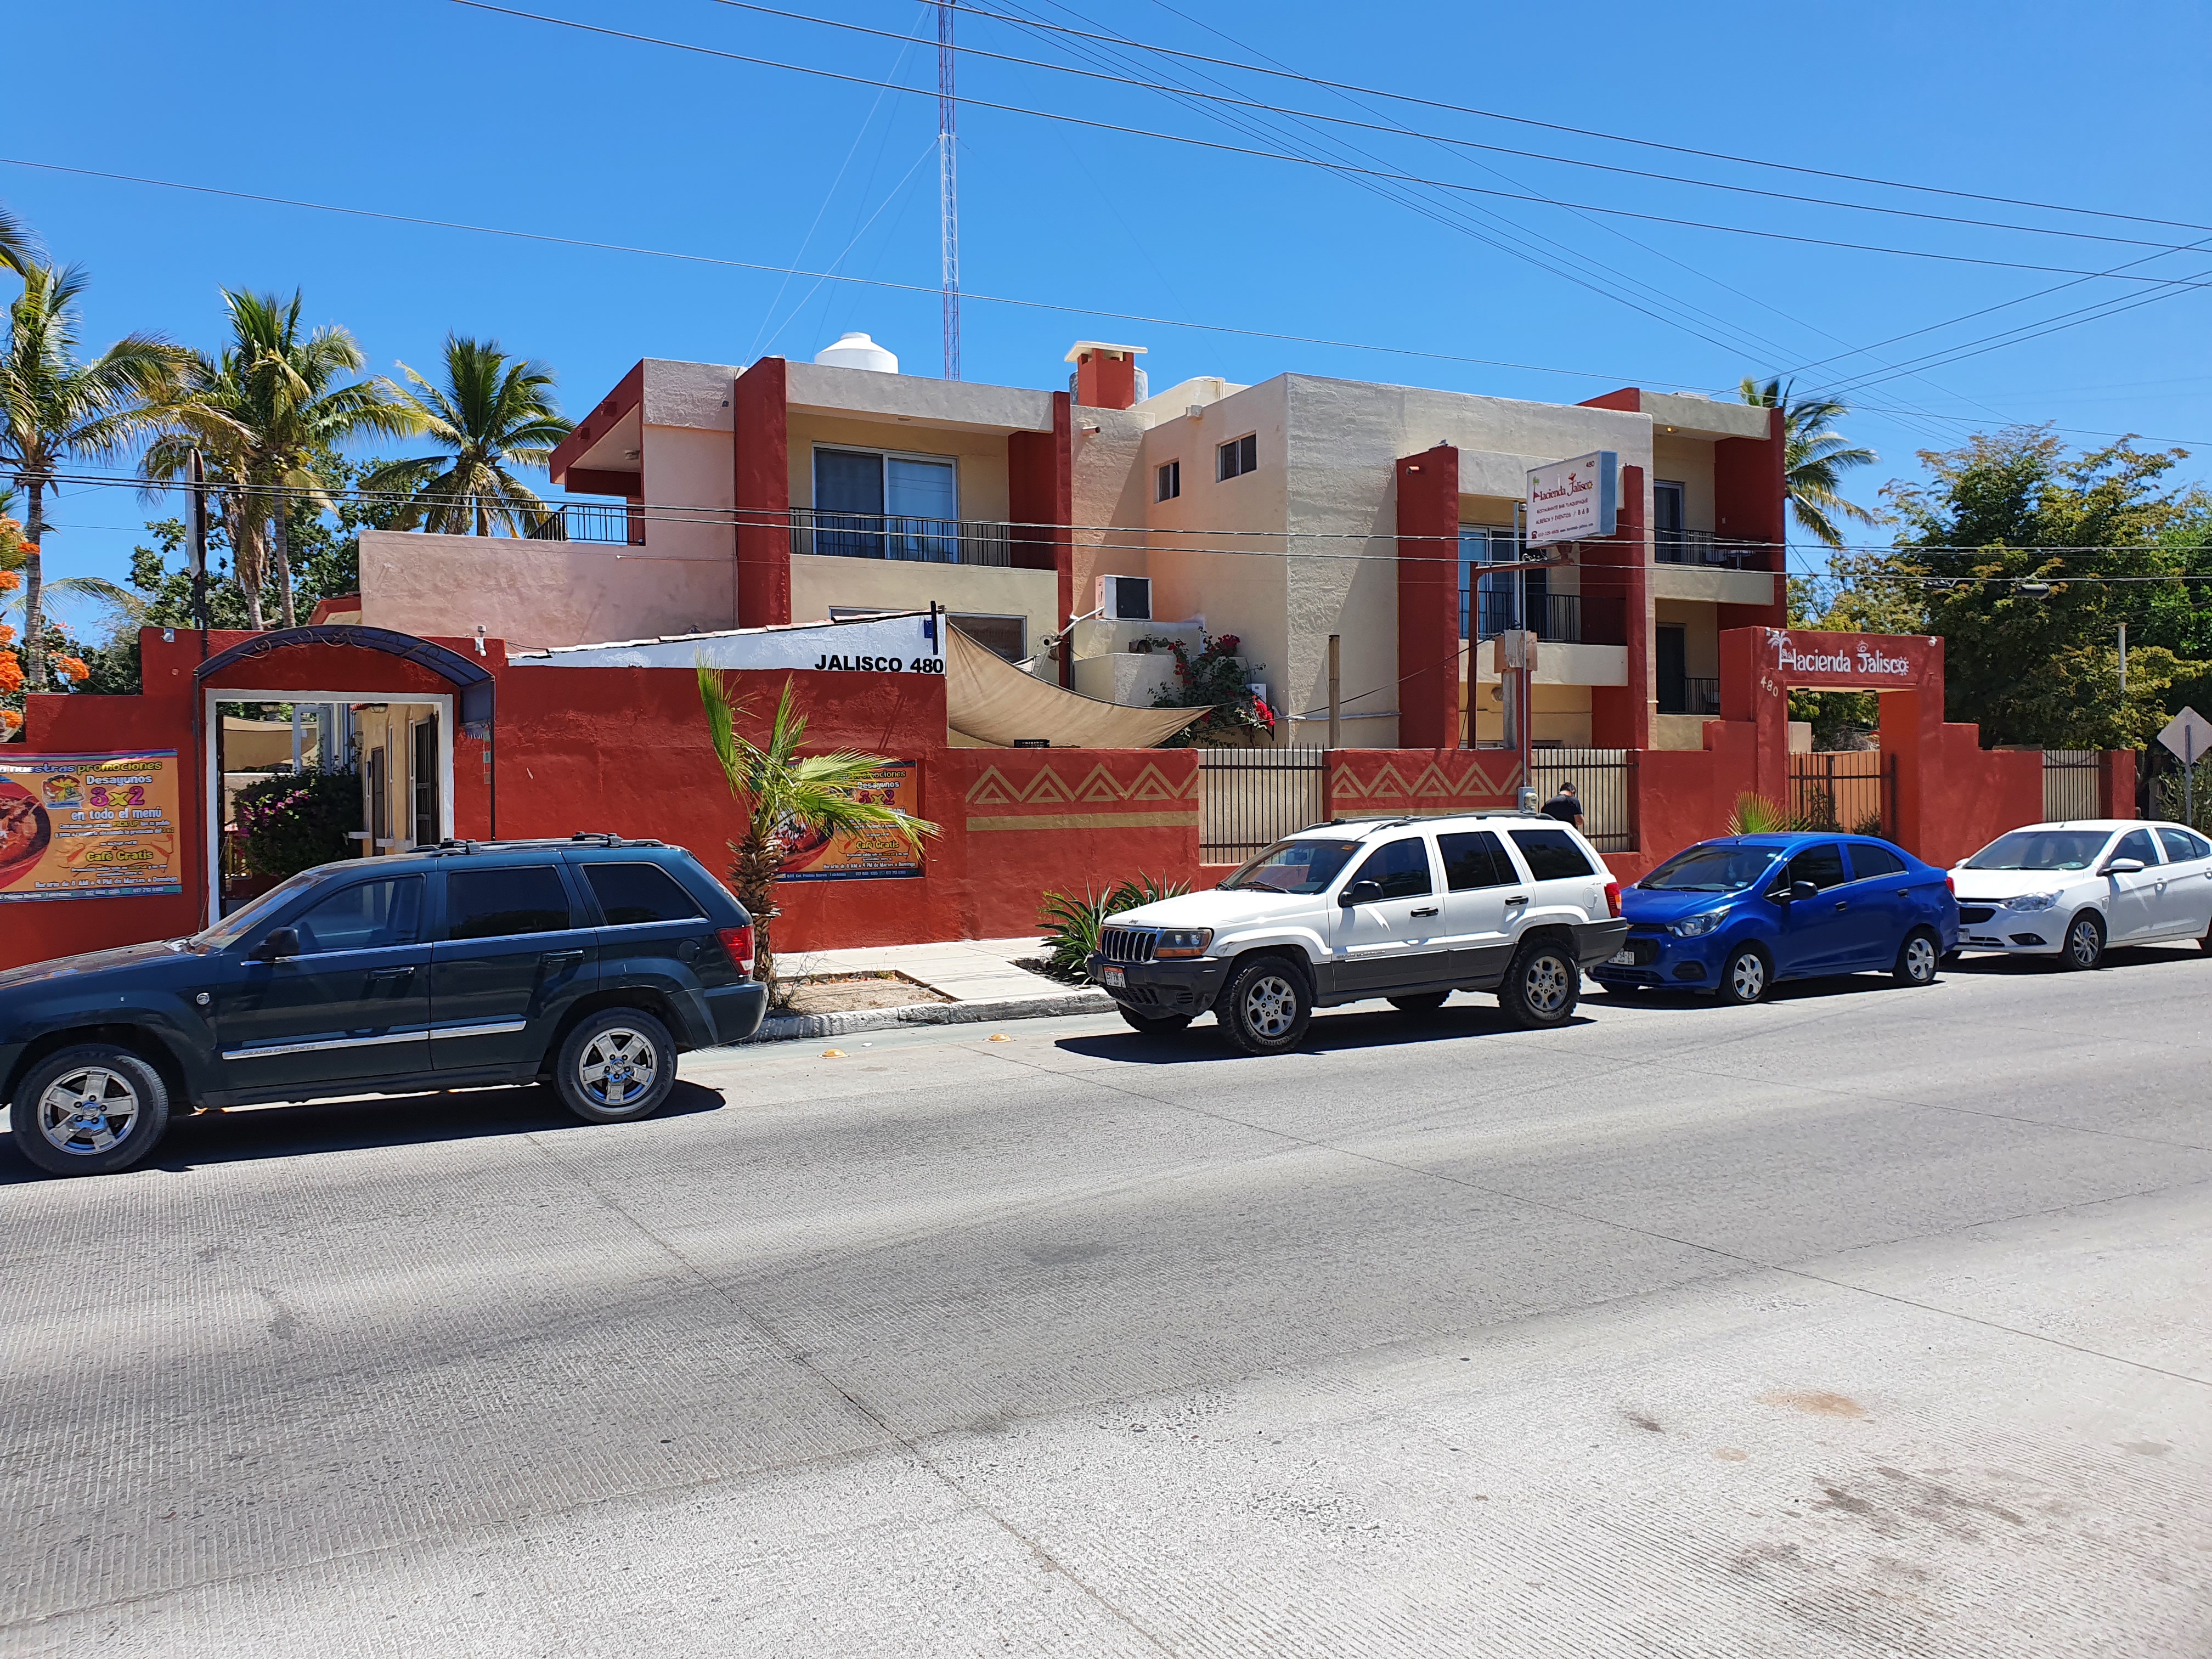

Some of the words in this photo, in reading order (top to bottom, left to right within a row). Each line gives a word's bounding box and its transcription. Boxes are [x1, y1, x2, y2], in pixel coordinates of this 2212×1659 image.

[1533, 486, 1566, 503] Hacienda
[1567, 479, 1593, 496] Jalisco
[815, 654, 902, 672] JALISCO
[910, 658, 944, 673] 480
[1778, 643, 1851, 673] Hacienda
[1858, 650, 1909, 674] Jalisco
[1760, 676, 1779, 697] 480
[10, 763, 75, 774] nuestras
[77, 761, 162, 775] promociones
[86, 775, 153, 786] Desayunos
[857, 781, 900, 790] Desayunos
[90, 786, 145, 806] 3x2
[859, 789, 895, 805] 3x2
[71, 811, 85, 820] en
[89, 808, 114, 820] todo
[119, 807, 129, 819] el
[132, 806, 161, 819] menú
[856, 840, 873, 849] Café
[876, 840, 899, 849] Gratis
[86, 851, 112, 861] Café
[116, 849, 154, 860] Gratis
[274, 1045, 316, 1053] CHEROKEE
